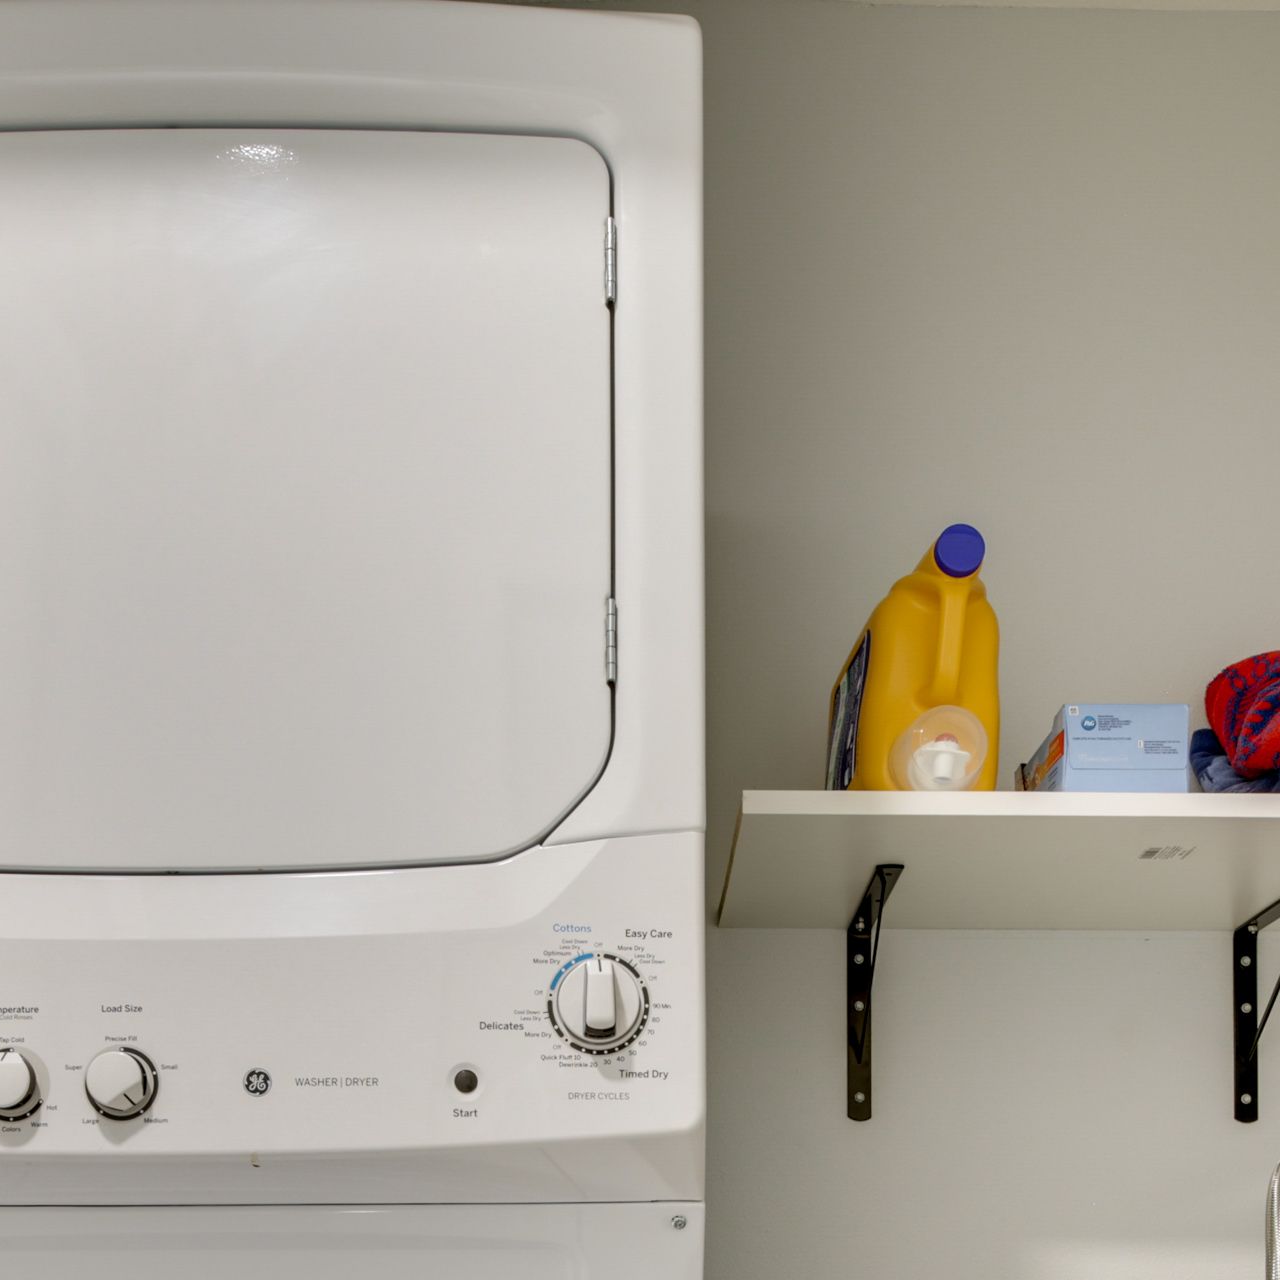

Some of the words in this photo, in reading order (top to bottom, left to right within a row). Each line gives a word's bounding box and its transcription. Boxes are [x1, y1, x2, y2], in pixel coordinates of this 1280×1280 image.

[553, 924, 592, 933] Cottons
[625, 929, 647, 940] Easy
[650, 930, 672, 938] Care
[101, 1004, 122, 1013] Load
[124, 1004, 143, 1013] Size
[479, 1022, 524, 1031] Delicates
[619, 1069, 649, 1079] Timed
[652, 1070, 668, 1080] Dry
[295, 1077, 338, 1087] WASHER
[345, 1077, 379, 1087] DRYER
[453, 1109, 478, 1118] Start
